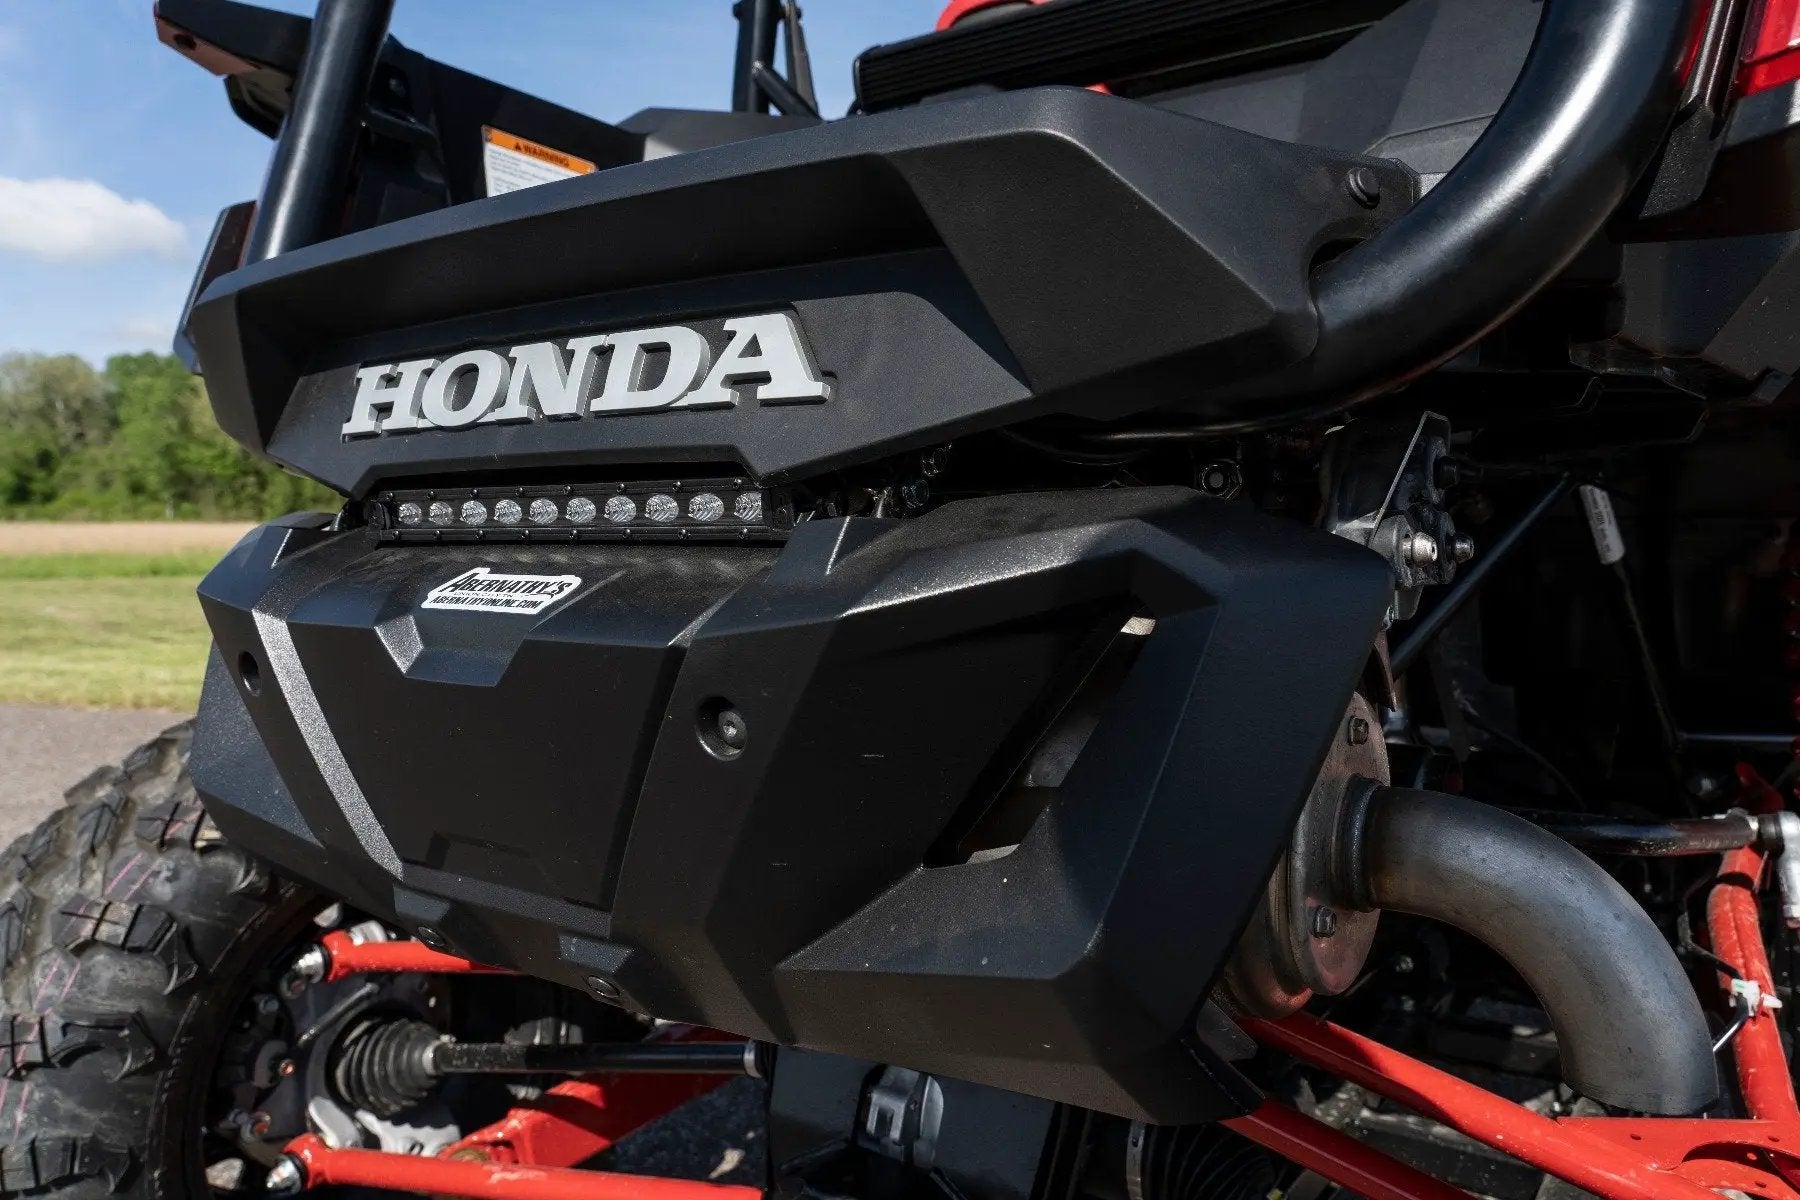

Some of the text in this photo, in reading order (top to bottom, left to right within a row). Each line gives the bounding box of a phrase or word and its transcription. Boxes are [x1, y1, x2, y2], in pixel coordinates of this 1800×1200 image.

[522, 144, 570, 168] WARNING
[341, 313, 831, 440] HONDA
[438, 573, 573, 598] ABERNATHY'S
[429, 595, 544, 609] ABERNATHYONLINE.COM
